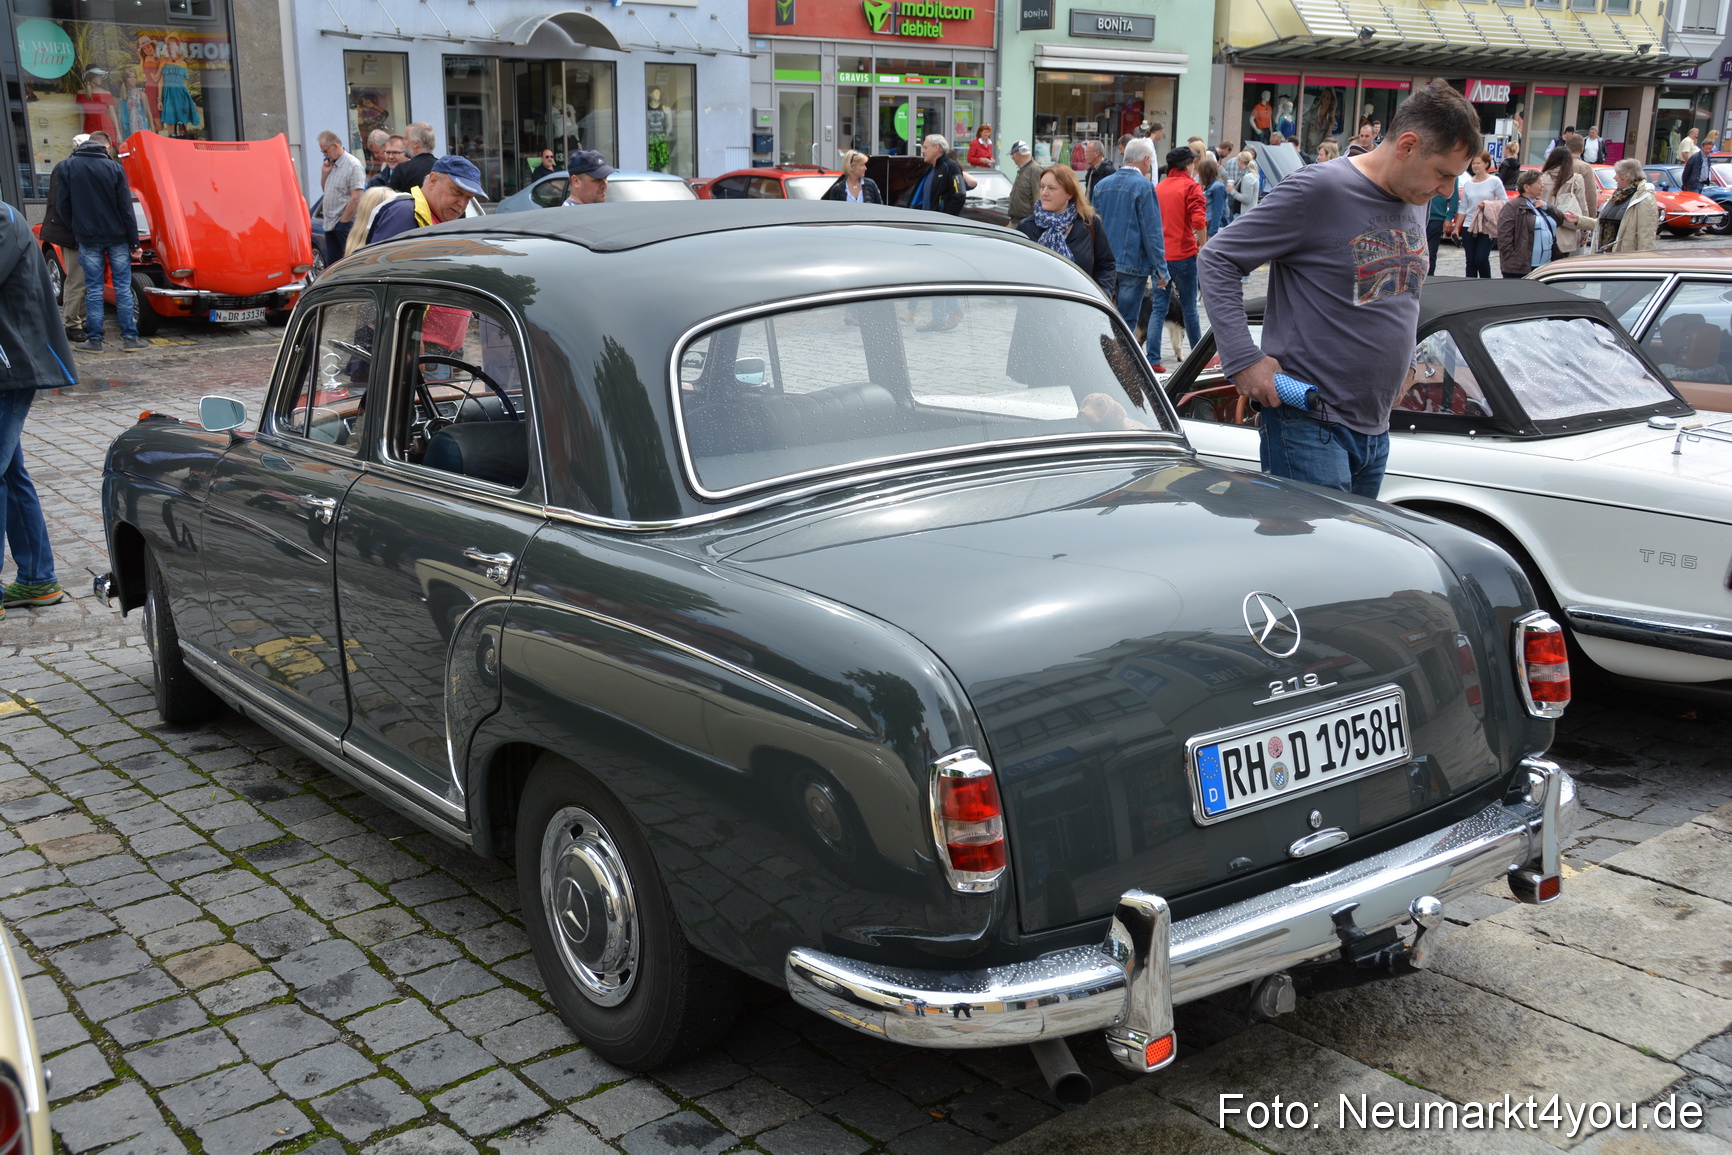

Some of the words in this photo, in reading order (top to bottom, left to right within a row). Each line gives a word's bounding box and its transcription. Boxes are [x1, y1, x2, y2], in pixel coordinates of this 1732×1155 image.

[901, 1, 975, 20] mobilcom
[901, 19, 944, 38] debitel
[840, 72, 869, 83] GRAVIS
[1472, 79, 1511, 103] ADLER
[216, 312, 223, 320] N
[228, 312, 240, 321] DR
[1639, 548, 1698, 570] TR6
[1268, 673, 1319, 696] 219
[1208, 787, 1219, 803] D
[1222, 740, 1269, 800] RH
[1288, 729, 1311, 781] D
[1316, 703, 1405, 774] 1958H
